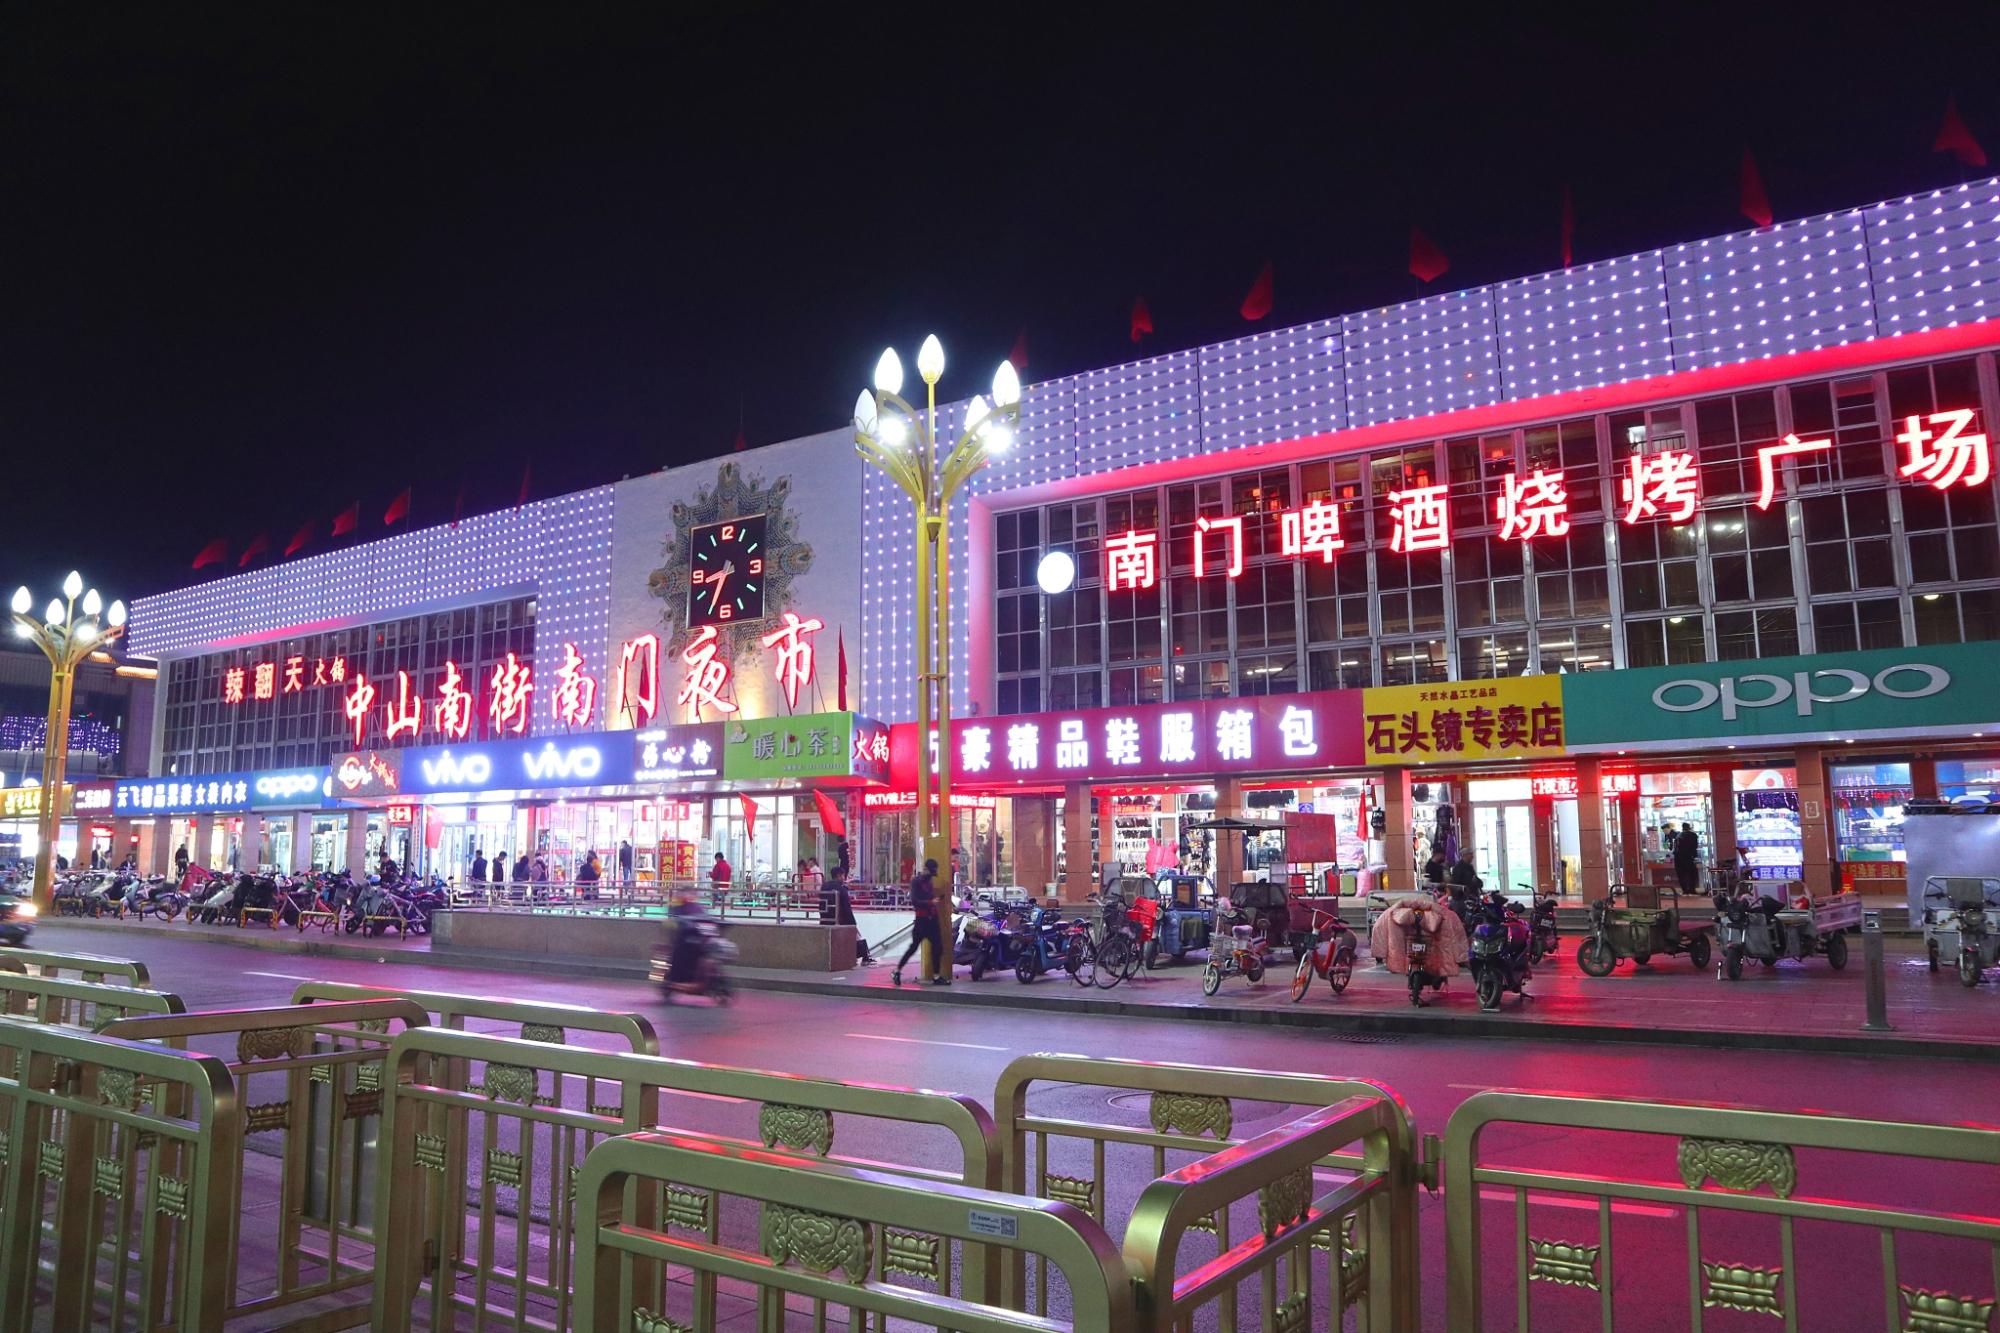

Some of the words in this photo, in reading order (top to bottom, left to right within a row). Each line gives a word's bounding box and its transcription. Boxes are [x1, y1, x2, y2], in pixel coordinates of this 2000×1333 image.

[1104, 406, 1992, 592] 南门啤酒烧烤广场
[722, 525, 734, 540] 12
[692, 569, 704, 584] 9
[749, 559, 762, 574] 3
[719, 604, 731, 618] 6
[344, 612, 824, 747] 中山南街南门夜市
[1419, 687, 1498, 702] 天然水晶工艺品店
[1366, 700, 1563, 755] 石头镜专卖店
[752, 727, 829, 761] 暖心茶
[852, 729, 890, 762] 火锅
